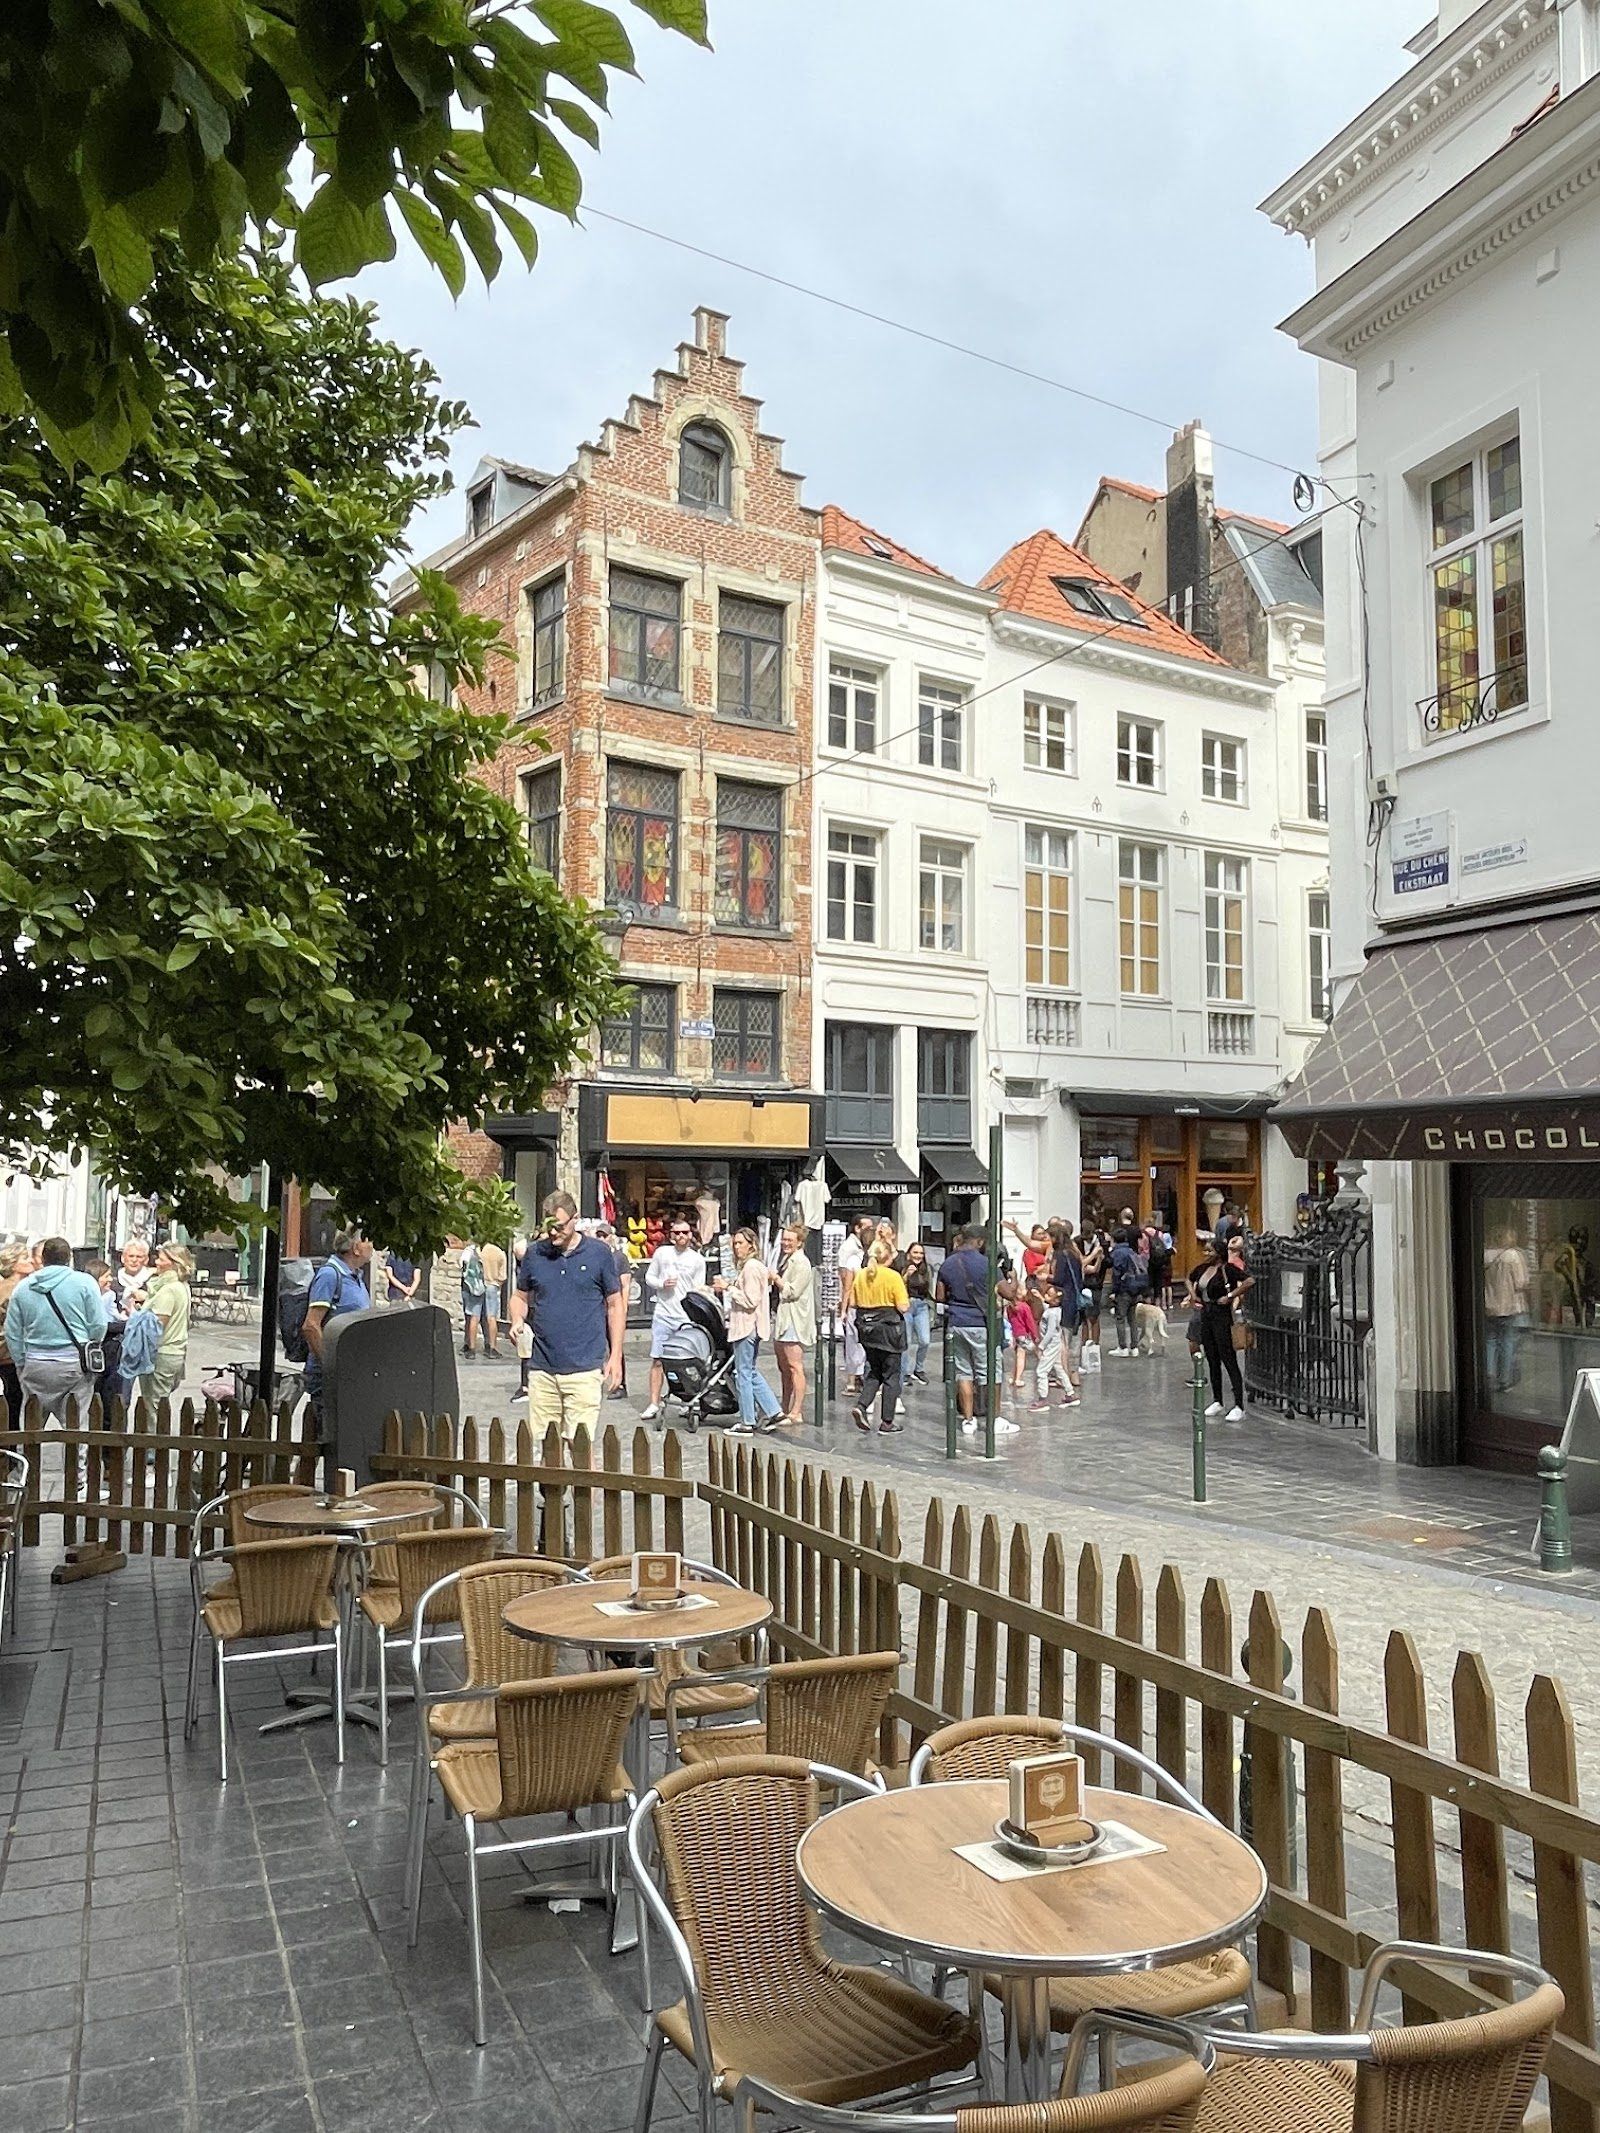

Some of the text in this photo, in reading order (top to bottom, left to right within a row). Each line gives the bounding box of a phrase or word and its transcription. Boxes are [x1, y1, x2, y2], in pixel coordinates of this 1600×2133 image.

[1394, 862, 1408, 875] RUE
[1410, 858, 1422, 871] DU
[1399, 872, 1443, 892] EIKSTRAAT
[1424, 1126, 1600, 1151] CHOCOL
[860, 1183, 909, 1194] ELISABETH
[948, 1184, 989, 1195] ELISABET
